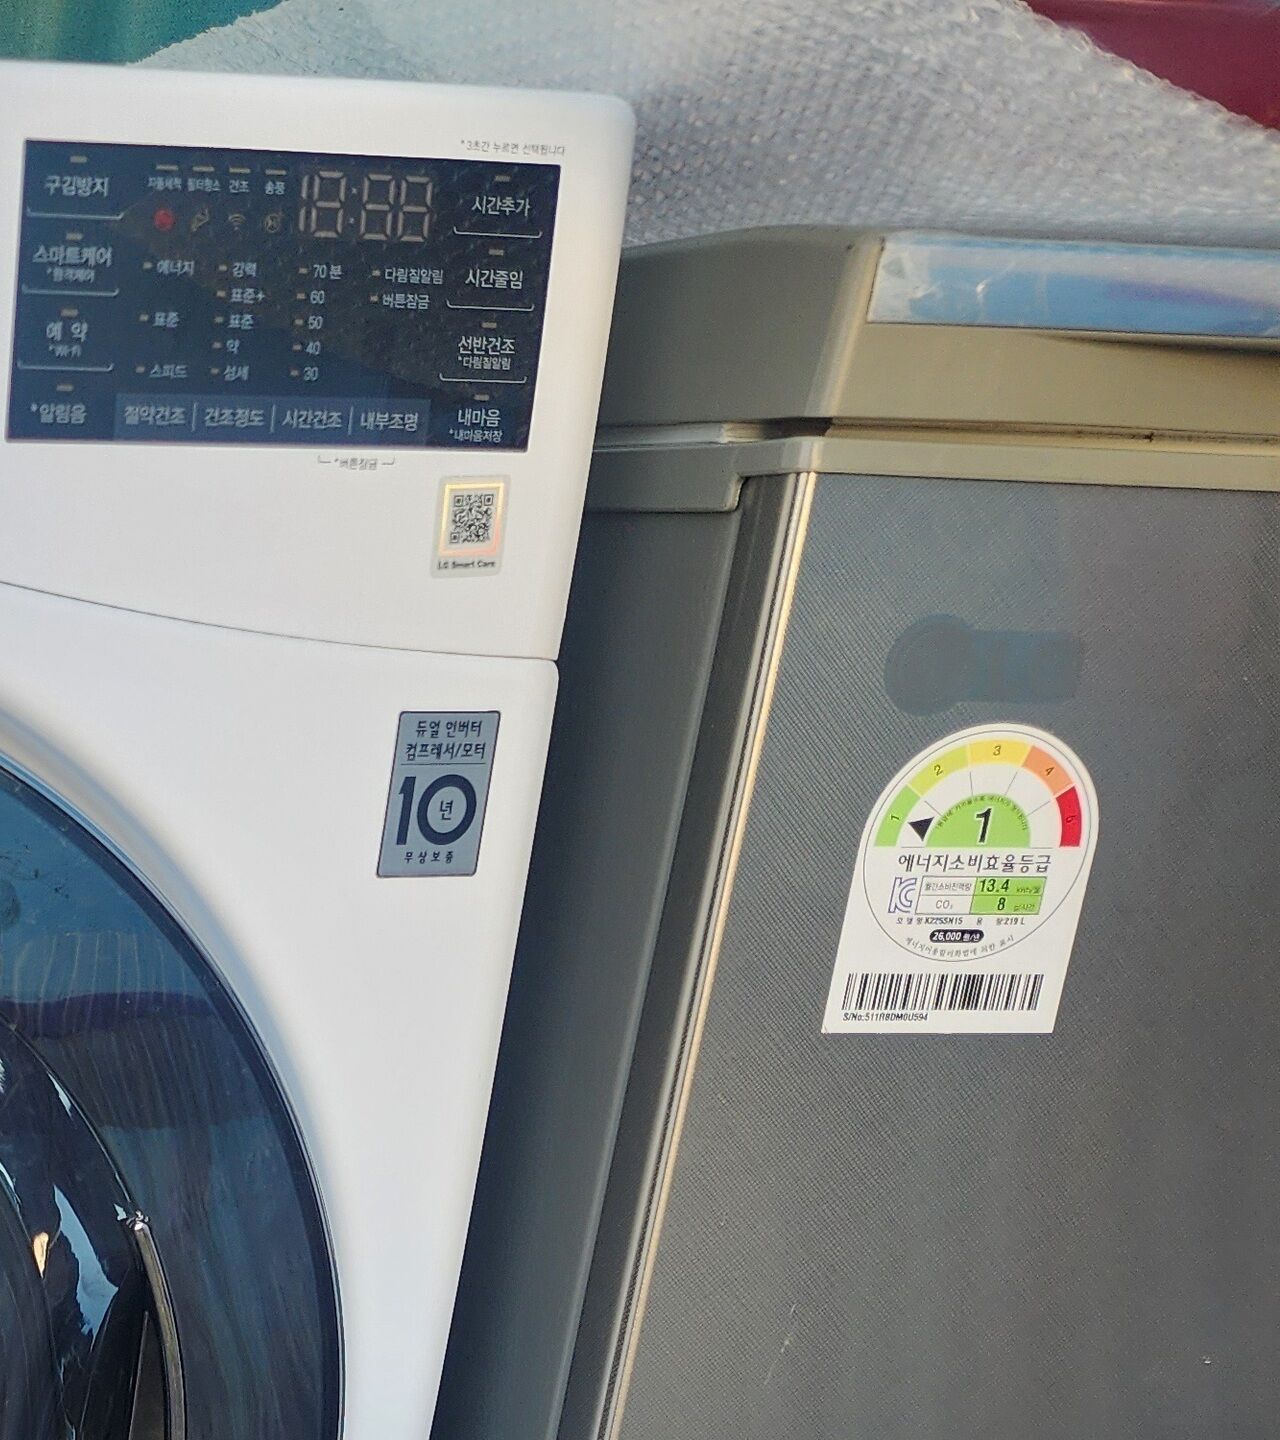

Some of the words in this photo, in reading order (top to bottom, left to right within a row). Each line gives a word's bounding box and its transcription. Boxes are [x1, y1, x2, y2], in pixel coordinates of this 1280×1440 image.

[471, 195, 532, 218] 시간추가
[465, 268, 524, 290] 시간줄임
[458, 335, 517, 356] 선반건조
[281, 407, 343, 430] 시간건조
[359, 409, 419, 432] 내부조명
[457, 407, 502, 429] 내마음
[415, 720, 441, 739] 듀얼
[445, 720, 483, 738] 인버터
[396, 774, 477, 845] 10
[439, 800, 454, 821] 년
[974, 806, 993, 844] 1
[897, 853, 1052, 873] 에너지소비효율등급
[978, 878, 1010, 894] 13.4
[997, 896, 1006, 912] 8
